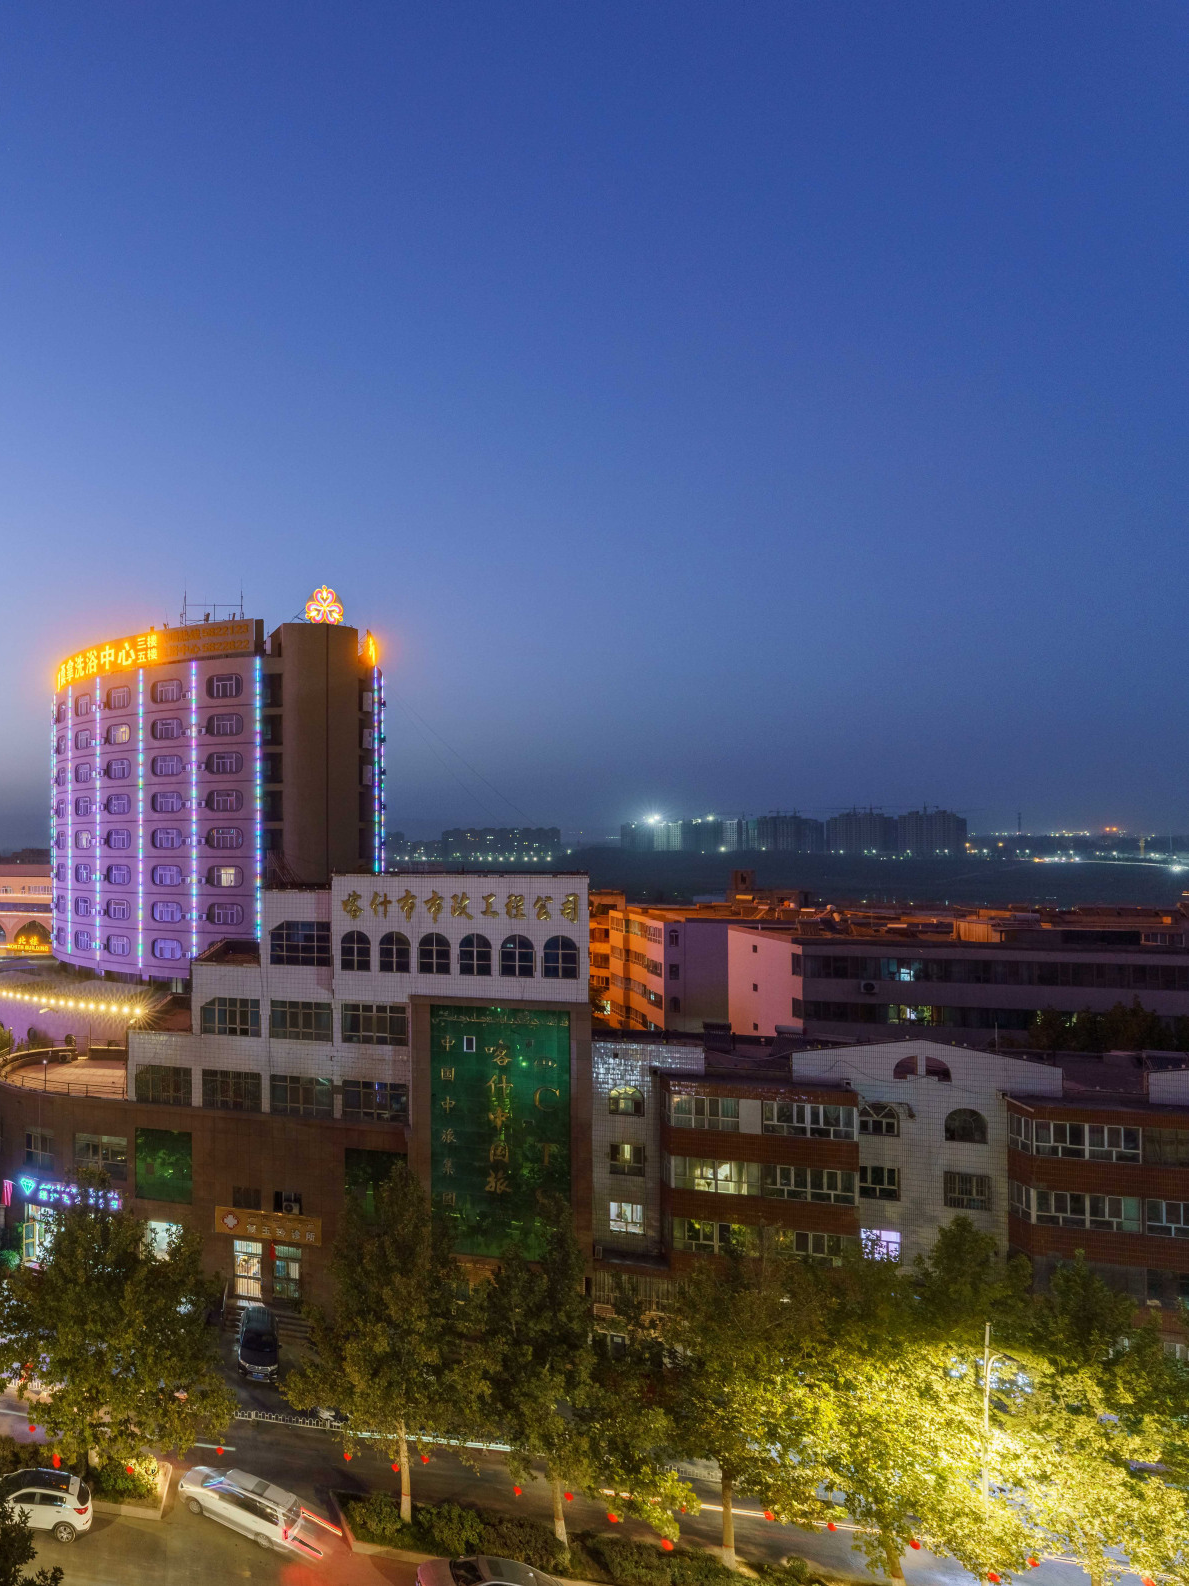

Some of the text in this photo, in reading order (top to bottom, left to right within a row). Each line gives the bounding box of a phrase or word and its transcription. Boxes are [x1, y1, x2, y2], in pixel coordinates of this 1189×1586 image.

[57, 643, 135, 692] 桑拿洗浴中心
[342, 889, 580, 924] 喀什市市政工程公司
[441, 1035, 456, 1206] 中国中旅集团
